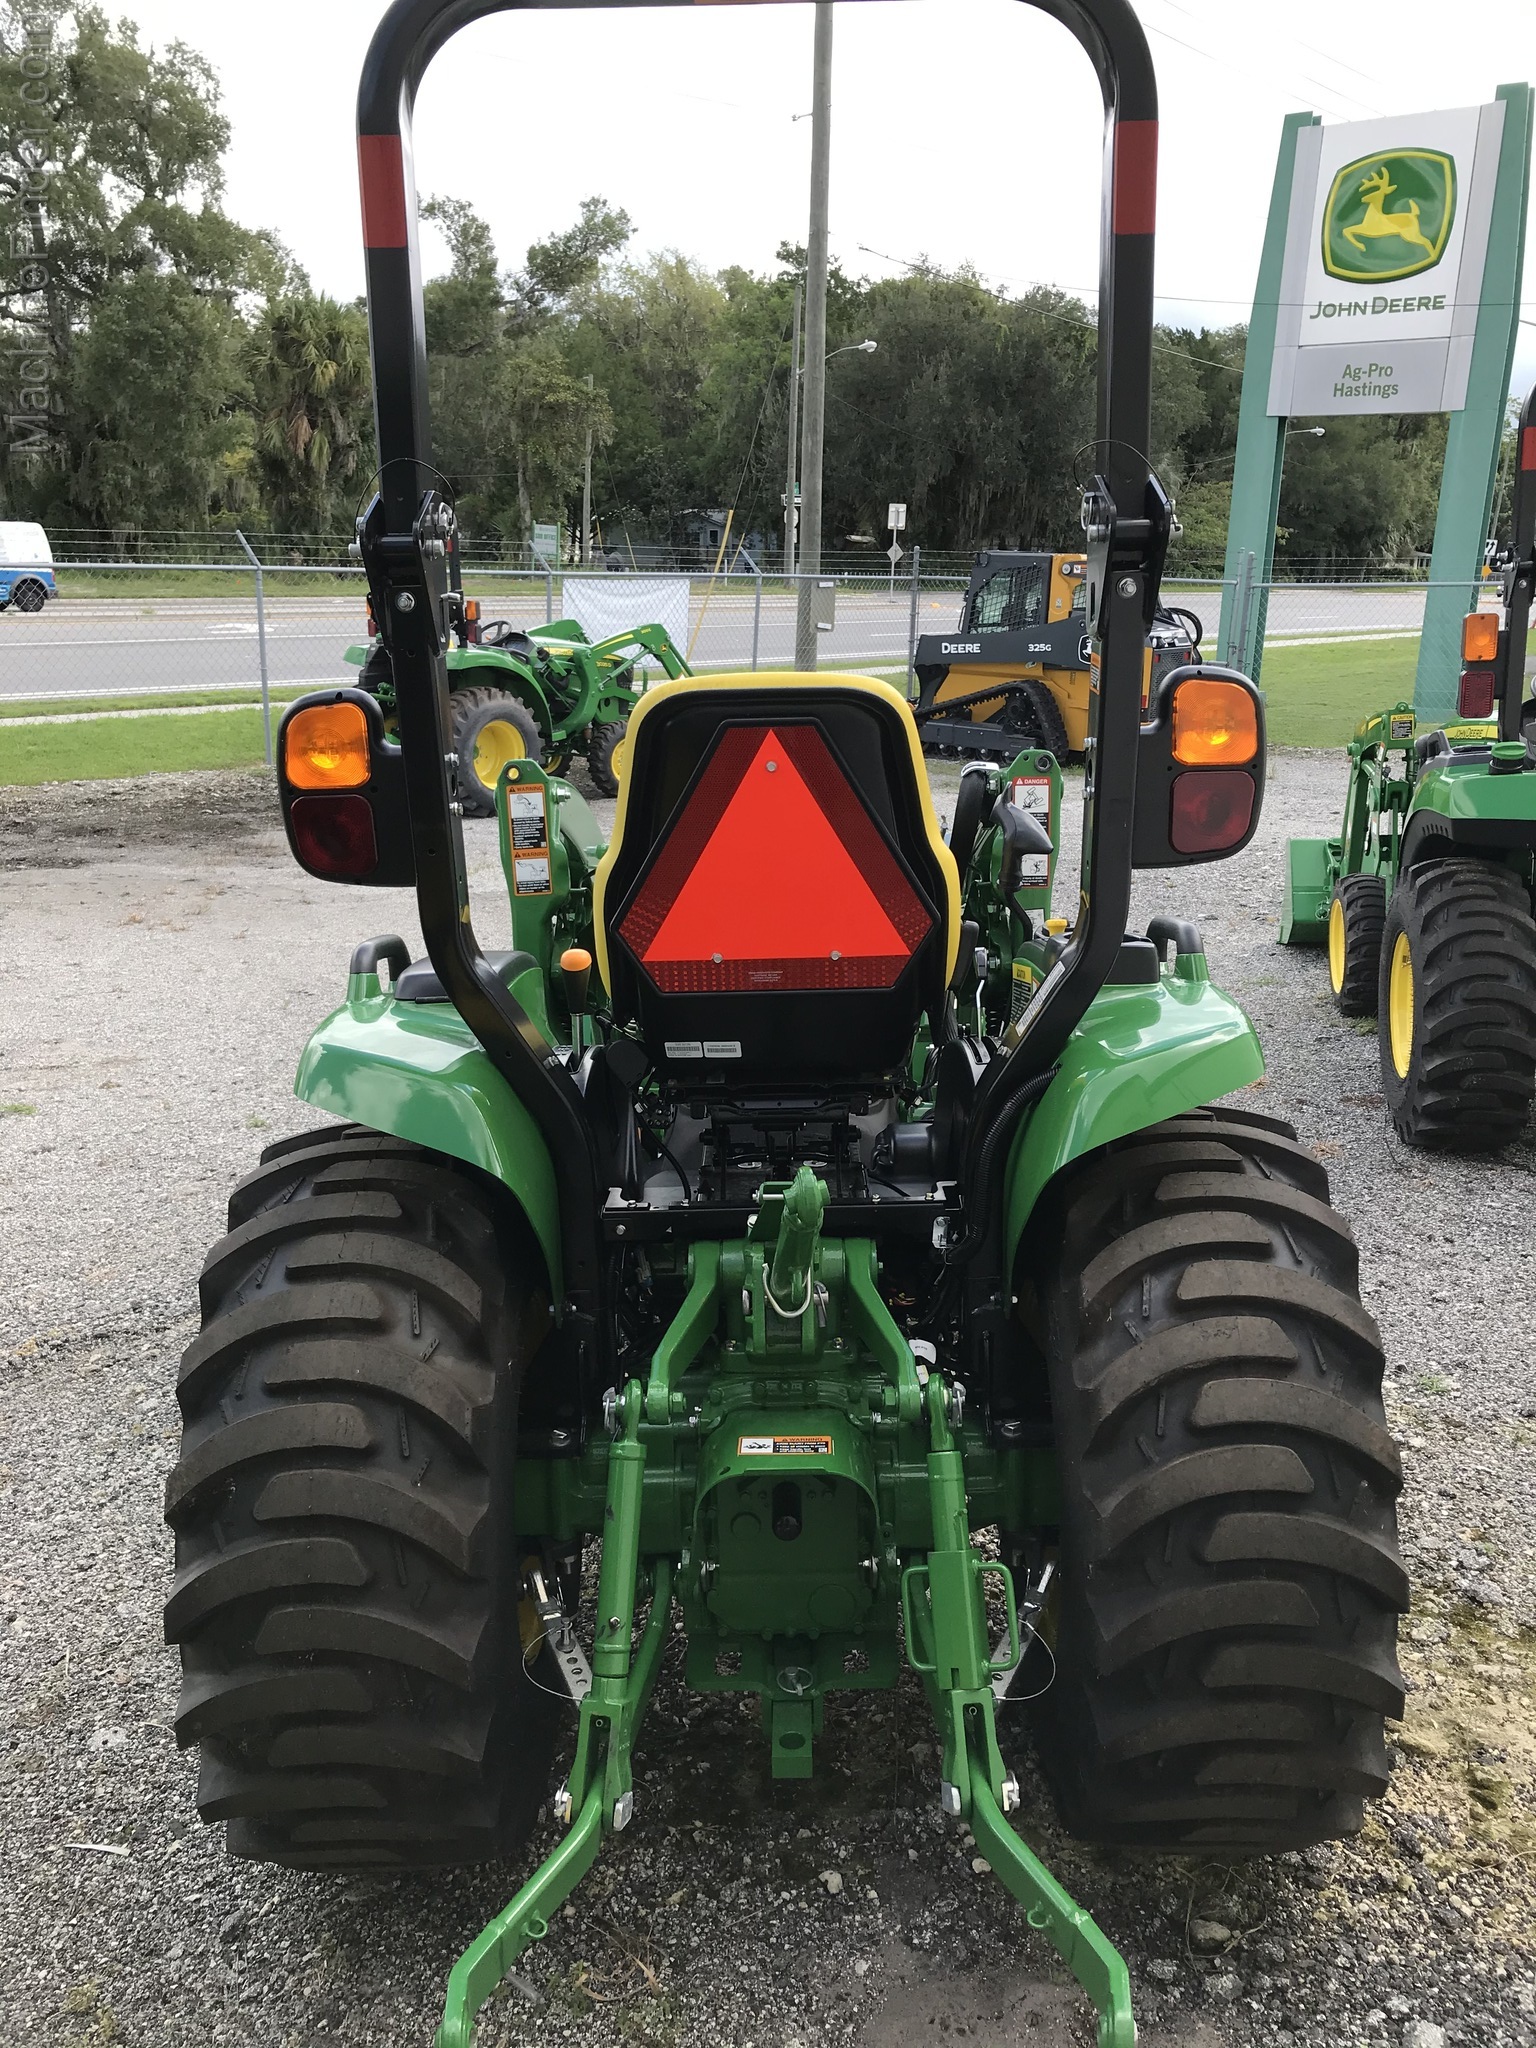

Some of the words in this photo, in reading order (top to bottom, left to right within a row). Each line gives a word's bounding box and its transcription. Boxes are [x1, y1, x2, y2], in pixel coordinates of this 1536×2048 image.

[1309, 300, 1367, 320] JOHN
[1371, 294, 1446, 316] DEERE
[1342, 363, 1393, 381] Ag-Pro
[1333, 381, 1399, 399] Hastings
[941, 642, 981, 654] DEERE
[1028, 643, 1052, 652] 325G
